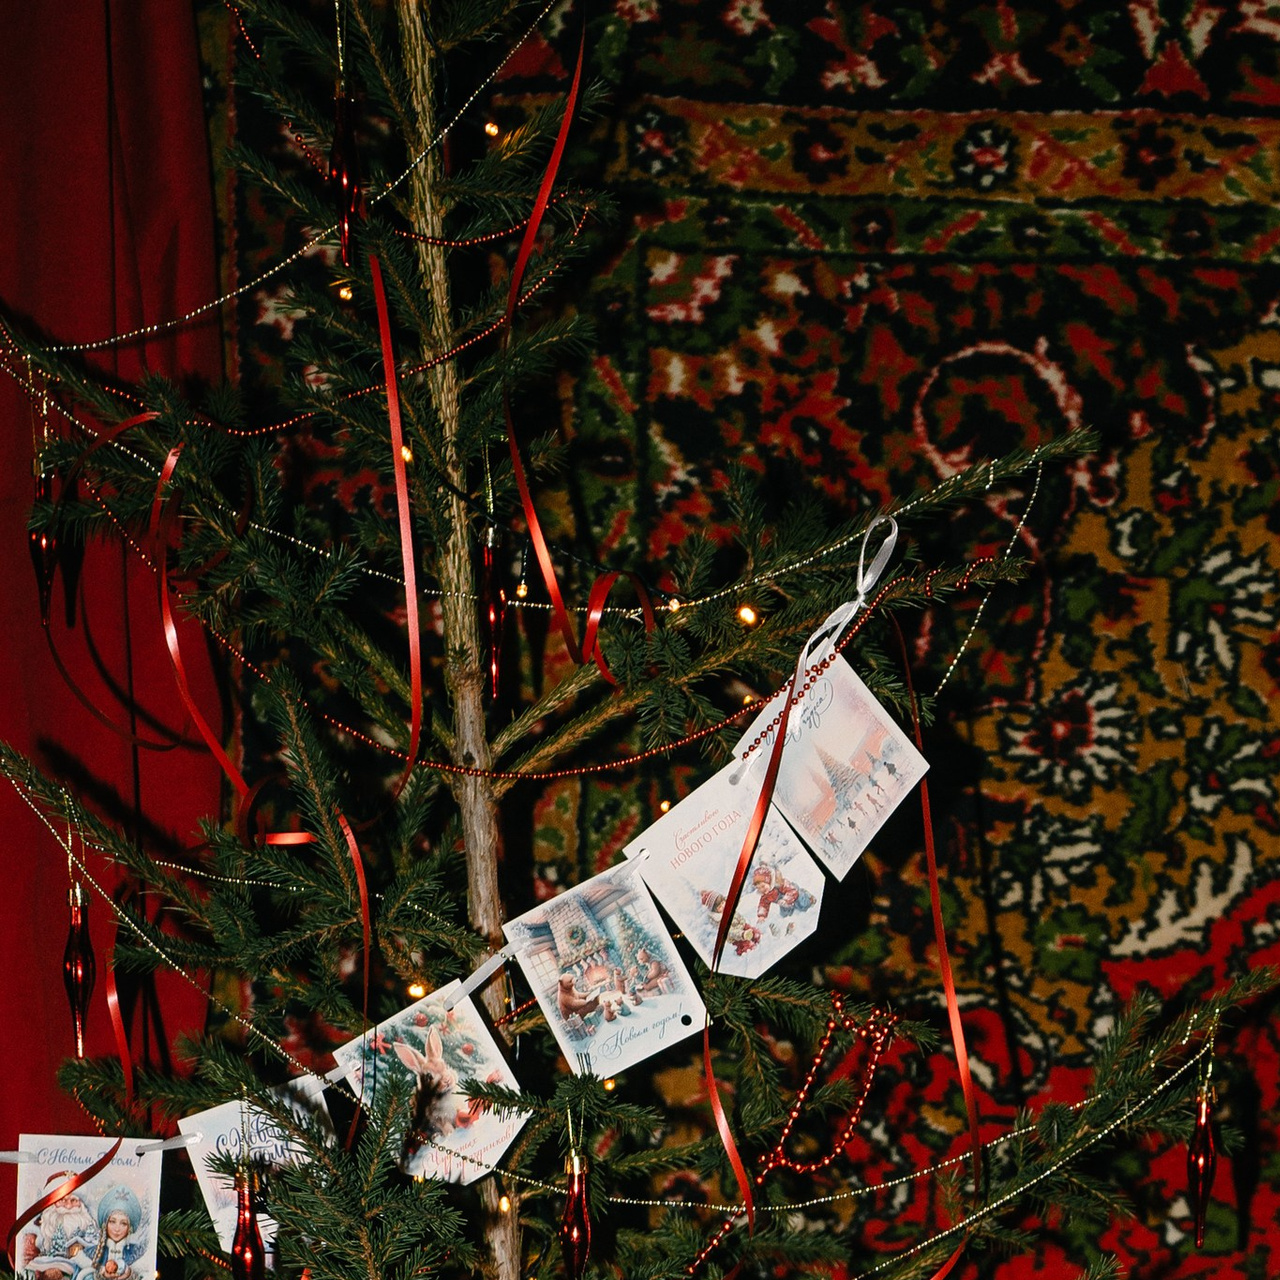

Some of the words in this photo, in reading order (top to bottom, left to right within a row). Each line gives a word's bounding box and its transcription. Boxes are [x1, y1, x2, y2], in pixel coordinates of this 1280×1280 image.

[670, 832, 712, 870] НОВОГО
[712, 810, 741, 836] ГОДА
[47, 1148, 93, 1165] Новым
